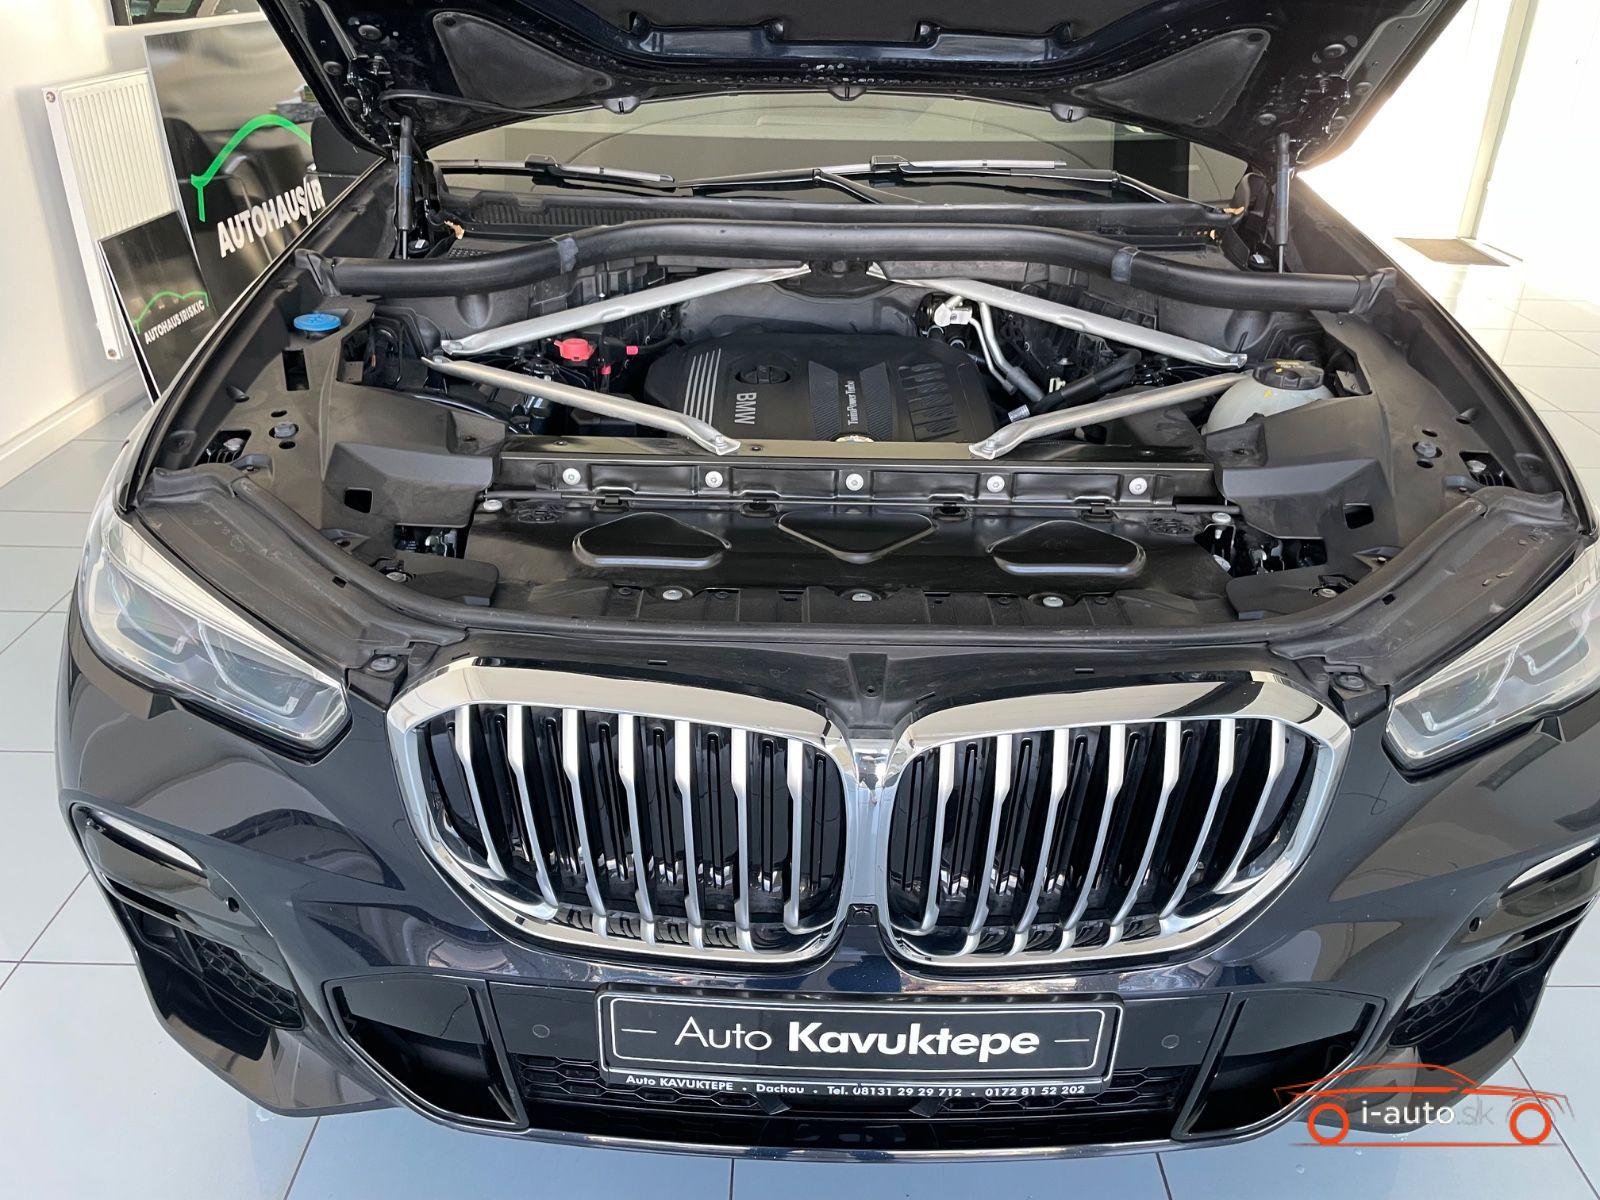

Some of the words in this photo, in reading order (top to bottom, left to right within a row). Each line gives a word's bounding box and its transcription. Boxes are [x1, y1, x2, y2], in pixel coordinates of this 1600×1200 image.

[217, 185, 307, 257] AUTOHAUS
[144, 313, 182, 345] AUTOHAUS
[179, 299, 205, 322] IRISKIC
[735, 392, 757, 424] BMW
[674, 1016, 773, 1050] Auto
[788, 1021, 1040, 1062] Kavuktepe
[626, 1075, 656, 1086] Auto
[660, 1077, 733, 1091] KAVUKTEPE
[756, 1083, 805, 1094] Dachau
[827, 1086, 849, 1095] Tel.
[852, 1086, 892, 1096] 08131
[897, 1087, 913, 1096] 29
[917, 1087, 934, 1097] 29
[938, 1088, 962, 1097] 712
[985, 1087, 1017, 1097] 0172
[1021, 1086, 1036, 1096] 81
[1041, 1086, 1057, 1095] 52
[1061, 1085, 1085, 1095] 202
